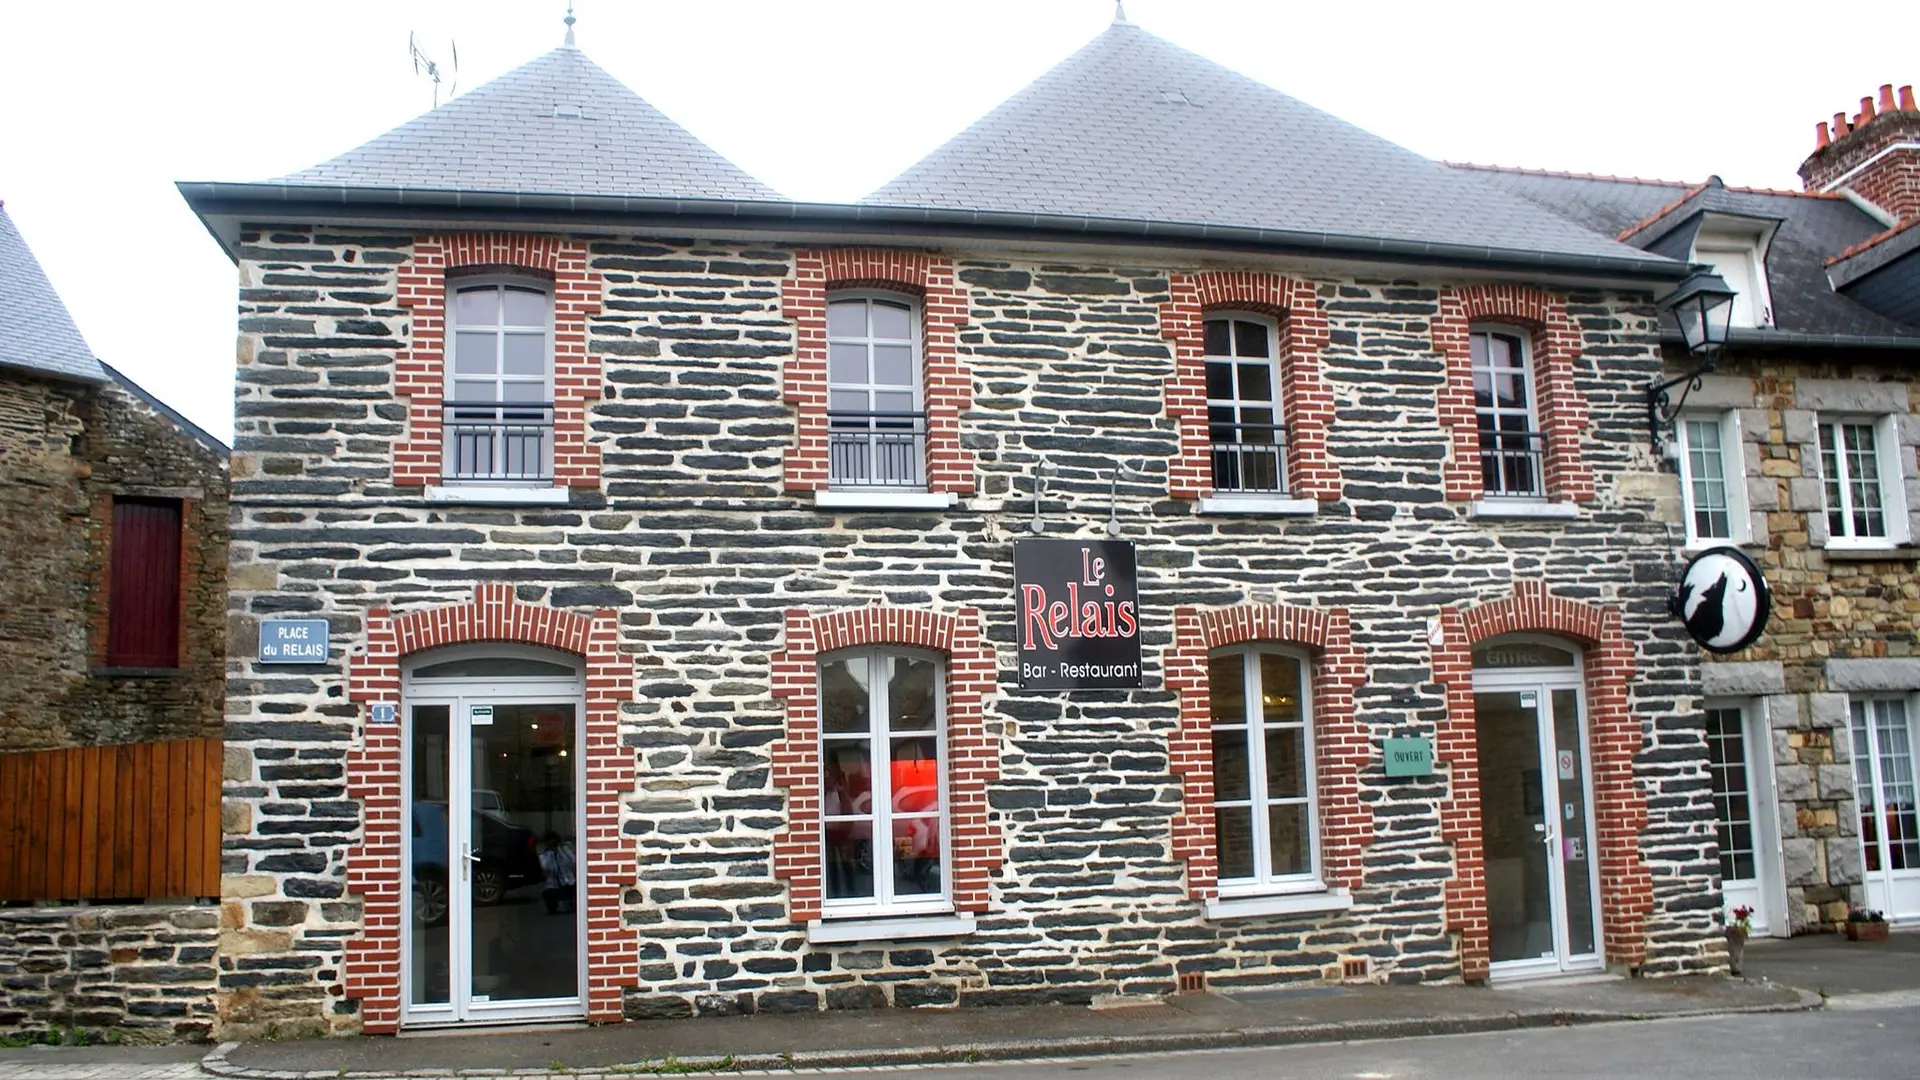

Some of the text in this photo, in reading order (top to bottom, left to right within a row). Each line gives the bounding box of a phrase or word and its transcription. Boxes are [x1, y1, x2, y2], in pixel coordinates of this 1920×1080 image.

[1081, 547, 1106, 586] Le
[1020, 582, 1137, 651] Relais
[278, 627, 309, 639] PLACE
[263, 643, 324, 656] du RELAIS
[1023, 663, 1047, 678] Bar
[1060, 662, 1138, 678] Restaurant
[1394, 751, 1423, 762] OUVERT
